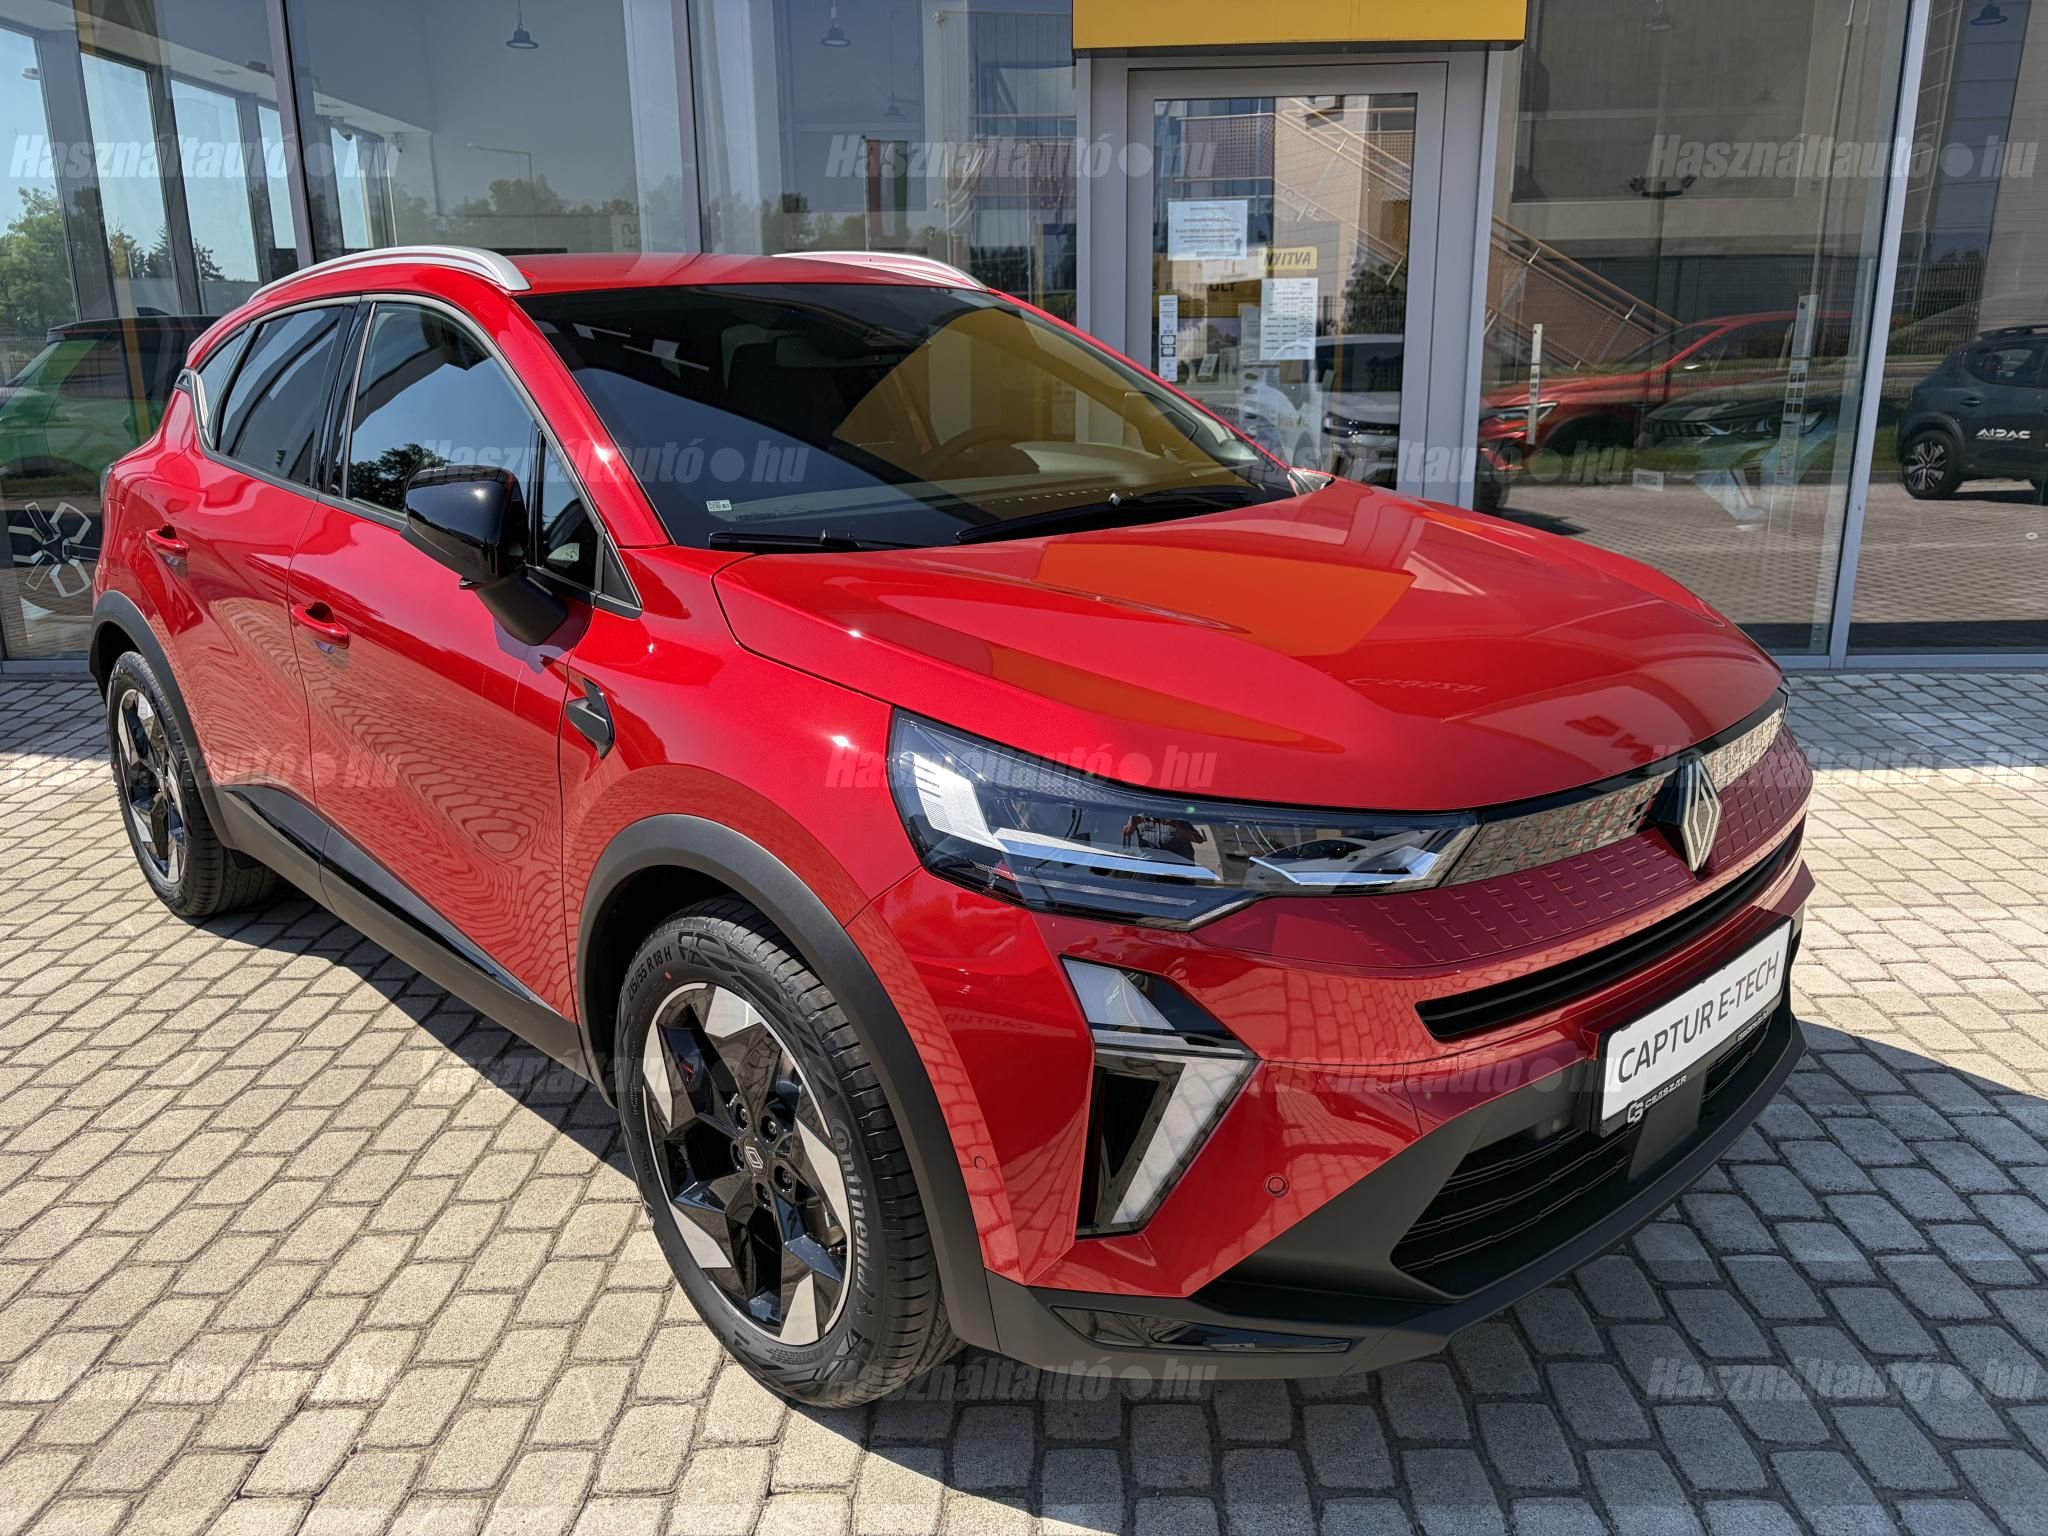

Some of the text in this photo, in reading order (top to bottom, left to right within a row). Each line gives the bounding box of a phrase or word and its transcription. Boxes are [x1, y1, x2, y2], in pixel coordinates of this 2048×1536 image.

[1263, 251, 1312, 267] NYITVA
[626, 963, 648, 1001] 215/55
[1618, 999, 1714, 1084] CAPTUR
[1718, 951, 1780, 1023] E-TECH
[829, 1118, 875, 1300] Continental
